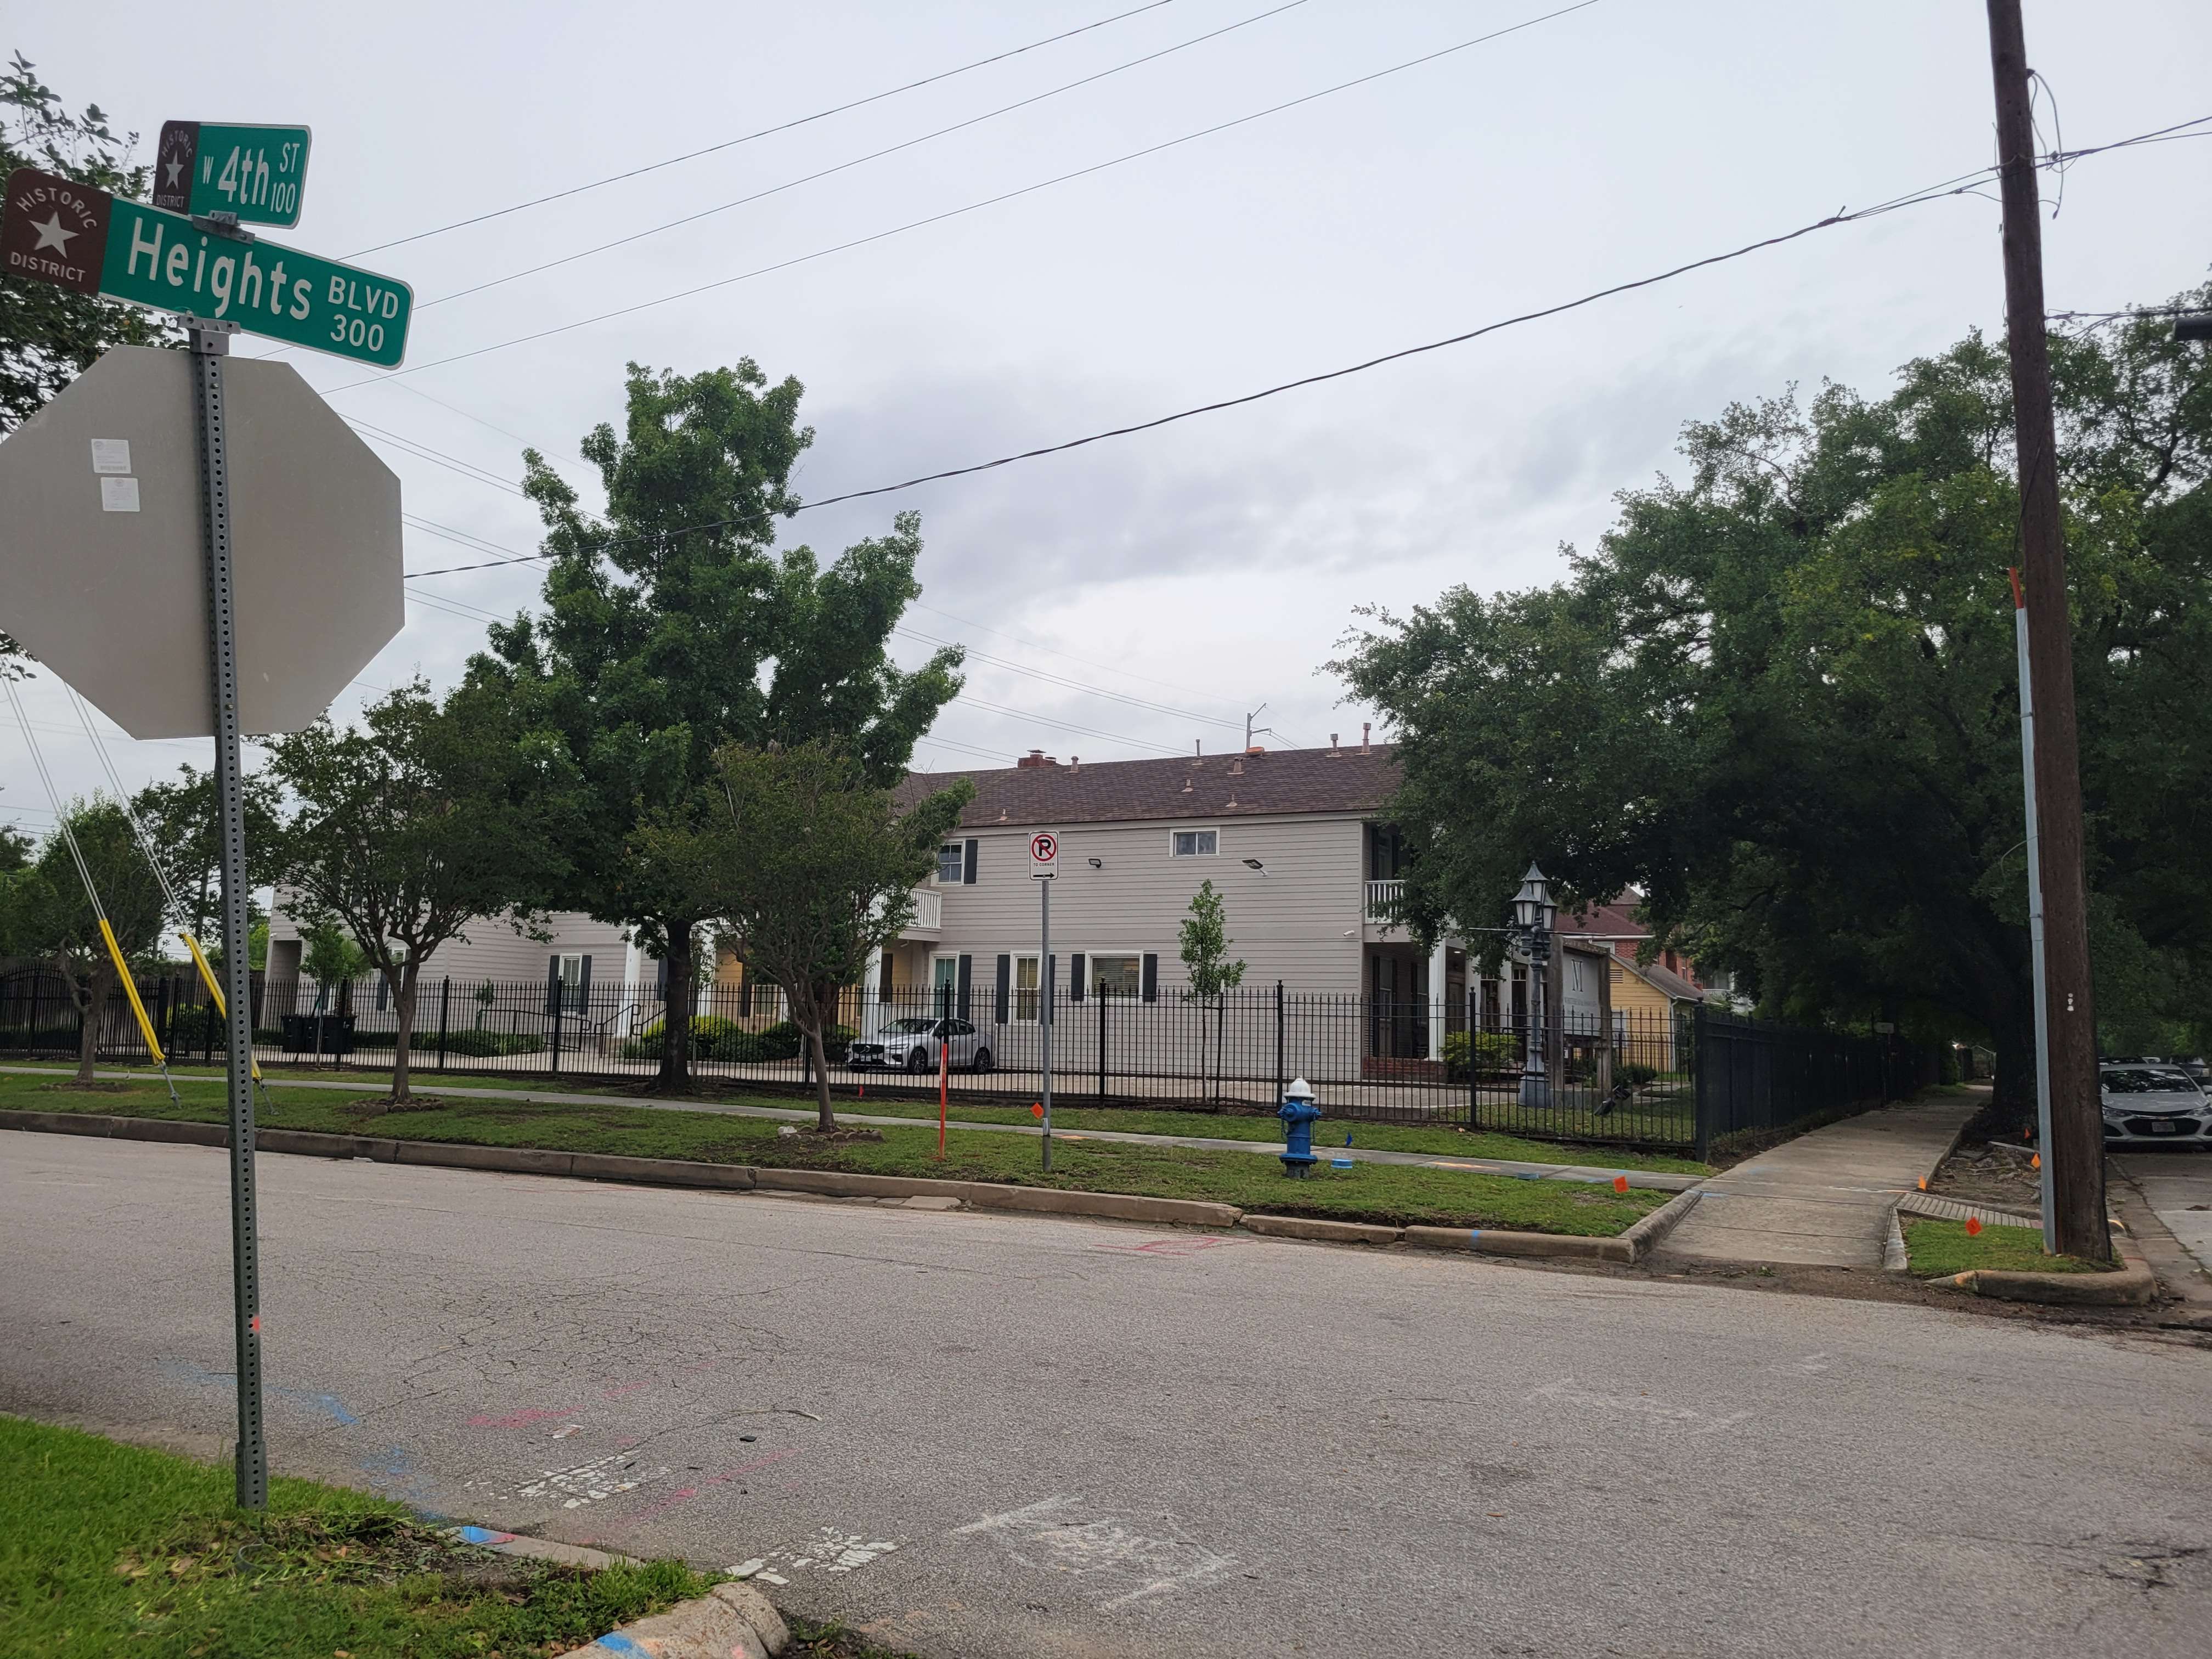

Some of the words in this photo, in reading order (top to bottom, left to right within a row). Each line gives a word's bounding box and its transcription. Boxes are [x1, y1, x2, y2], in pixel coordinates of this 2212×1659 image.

[162, 130, 192, 157] HISTORIC
[202, 155, 214, 184] W
[217, 145, 269, 206] 4th
[279, 142, 301, 173] ST
[16, 187, 98, 229] HISTORIC
[156, 195, 185, 208] DISTRICT
[270, 182, 296, 215] 100
[10, 251, 86, 283] DISTRICT
[127, 217, 313, 320] Heights
[328, 275, 399, 319] BLVD
[330, 314, 385, 352] 300
